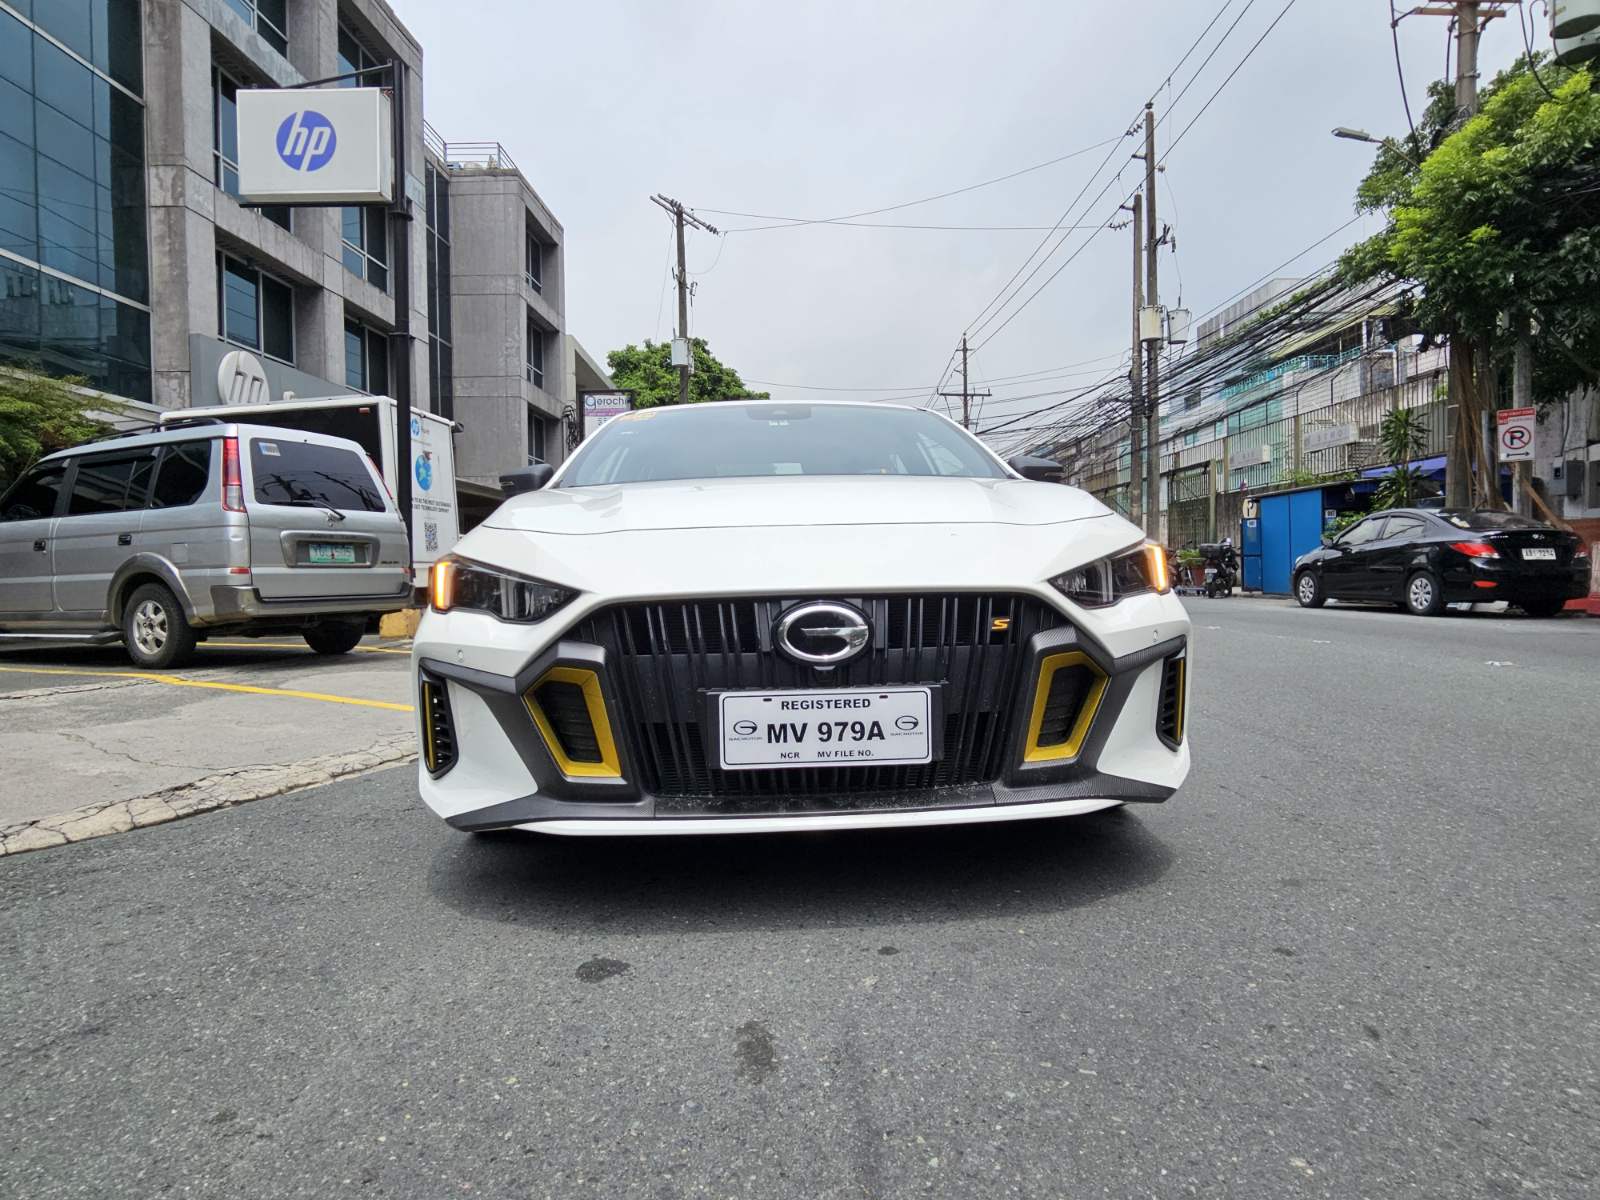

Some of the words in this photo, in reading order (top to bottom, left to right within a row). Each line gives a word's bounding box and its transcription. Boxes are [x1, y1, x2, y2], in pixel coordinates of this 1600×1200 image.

[282, 110, 332, 173] hp
[780, 698, 871, 711] REGISTERED
[766, 722, 808, 744] MV
[817, 720, 886, 743] 979A
[779, 751, 801, 760] NCR
[816, 750, 832, 758] MV
[834, 749, 856, 758] FILE
[857, 748, 875, 757] NO.
